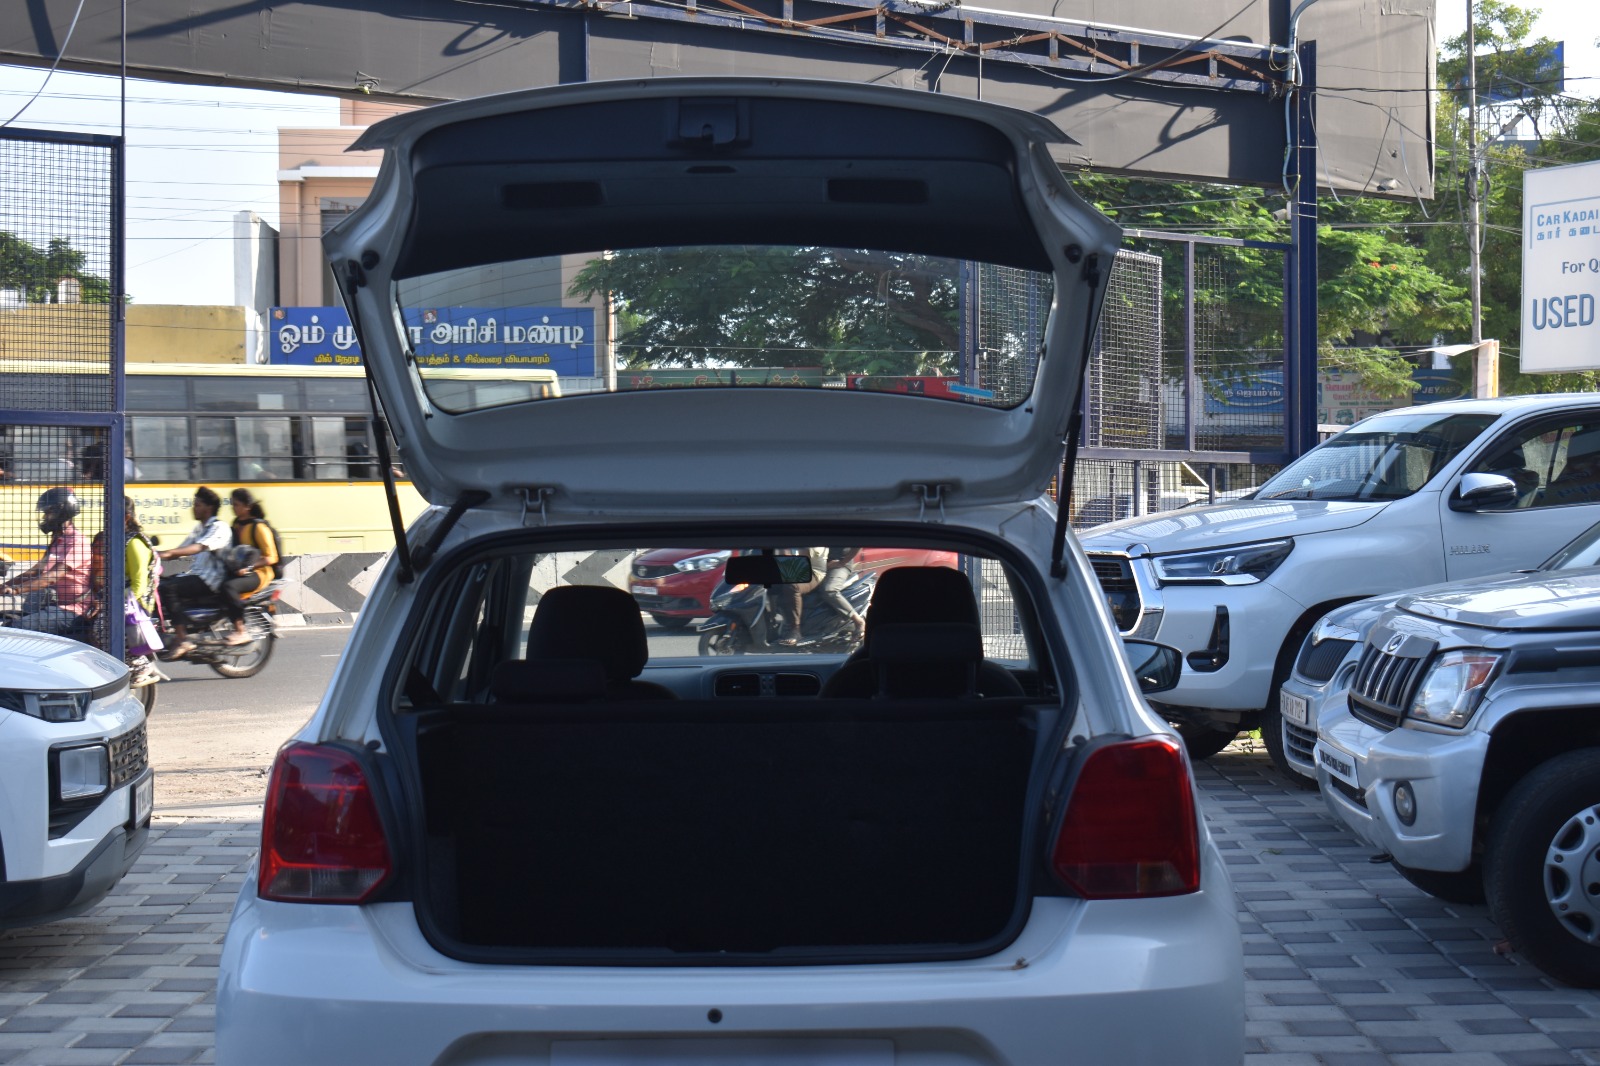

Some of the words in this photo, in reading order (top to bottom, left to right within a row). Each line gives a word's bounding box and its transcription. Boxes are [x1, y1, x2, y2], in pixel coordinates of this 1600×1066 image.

[1562, 261, 1585, 274] For
[1532, 293, 1595, 330] USED
[279, 315, 325, 353] ஓம்
[430, 317, 497, 345] அரிசி
[503, 316, 584, 349] மண்டி
[453, 354, 460, 363] &
